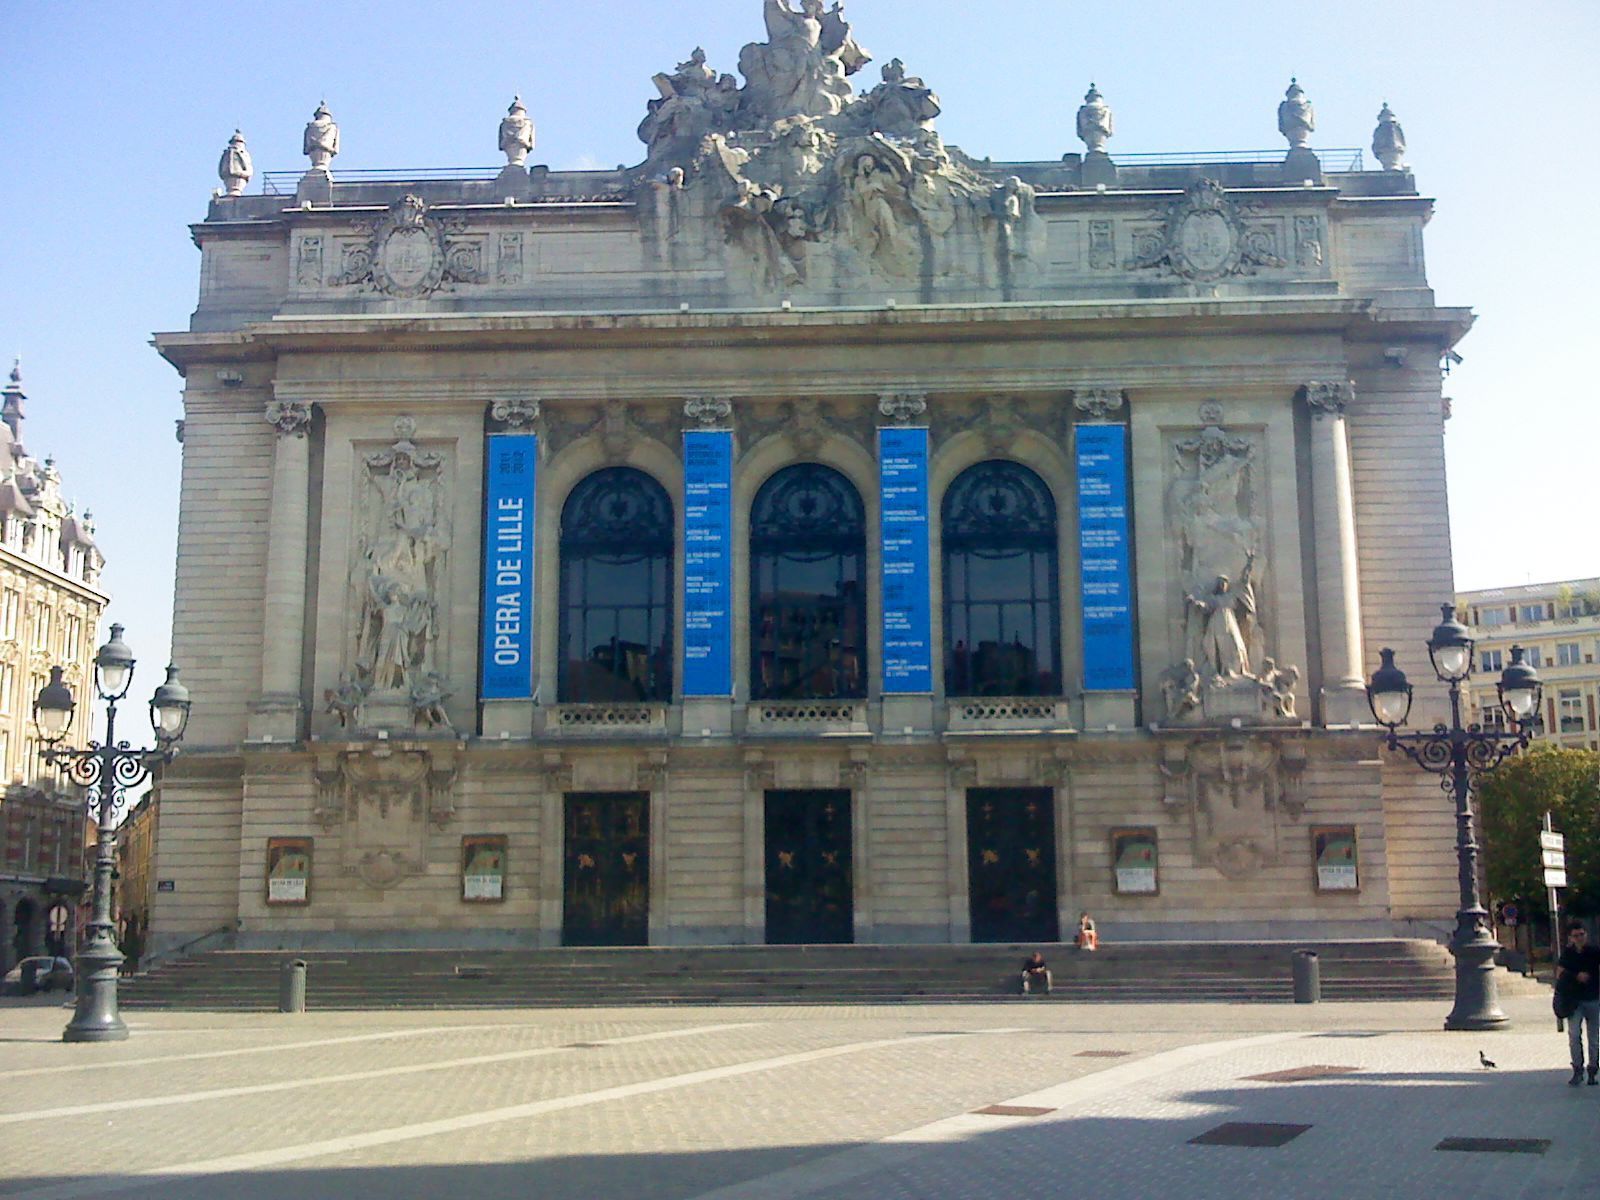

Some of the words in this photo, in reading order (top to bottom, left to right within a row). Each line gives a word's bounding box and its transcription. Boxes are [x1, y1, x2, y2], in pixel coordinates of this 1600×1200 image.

[498, 497, 524, 553] LILLE
[496, 559, 522, 586] DE
[494, 592, 522, 666] OPERA
